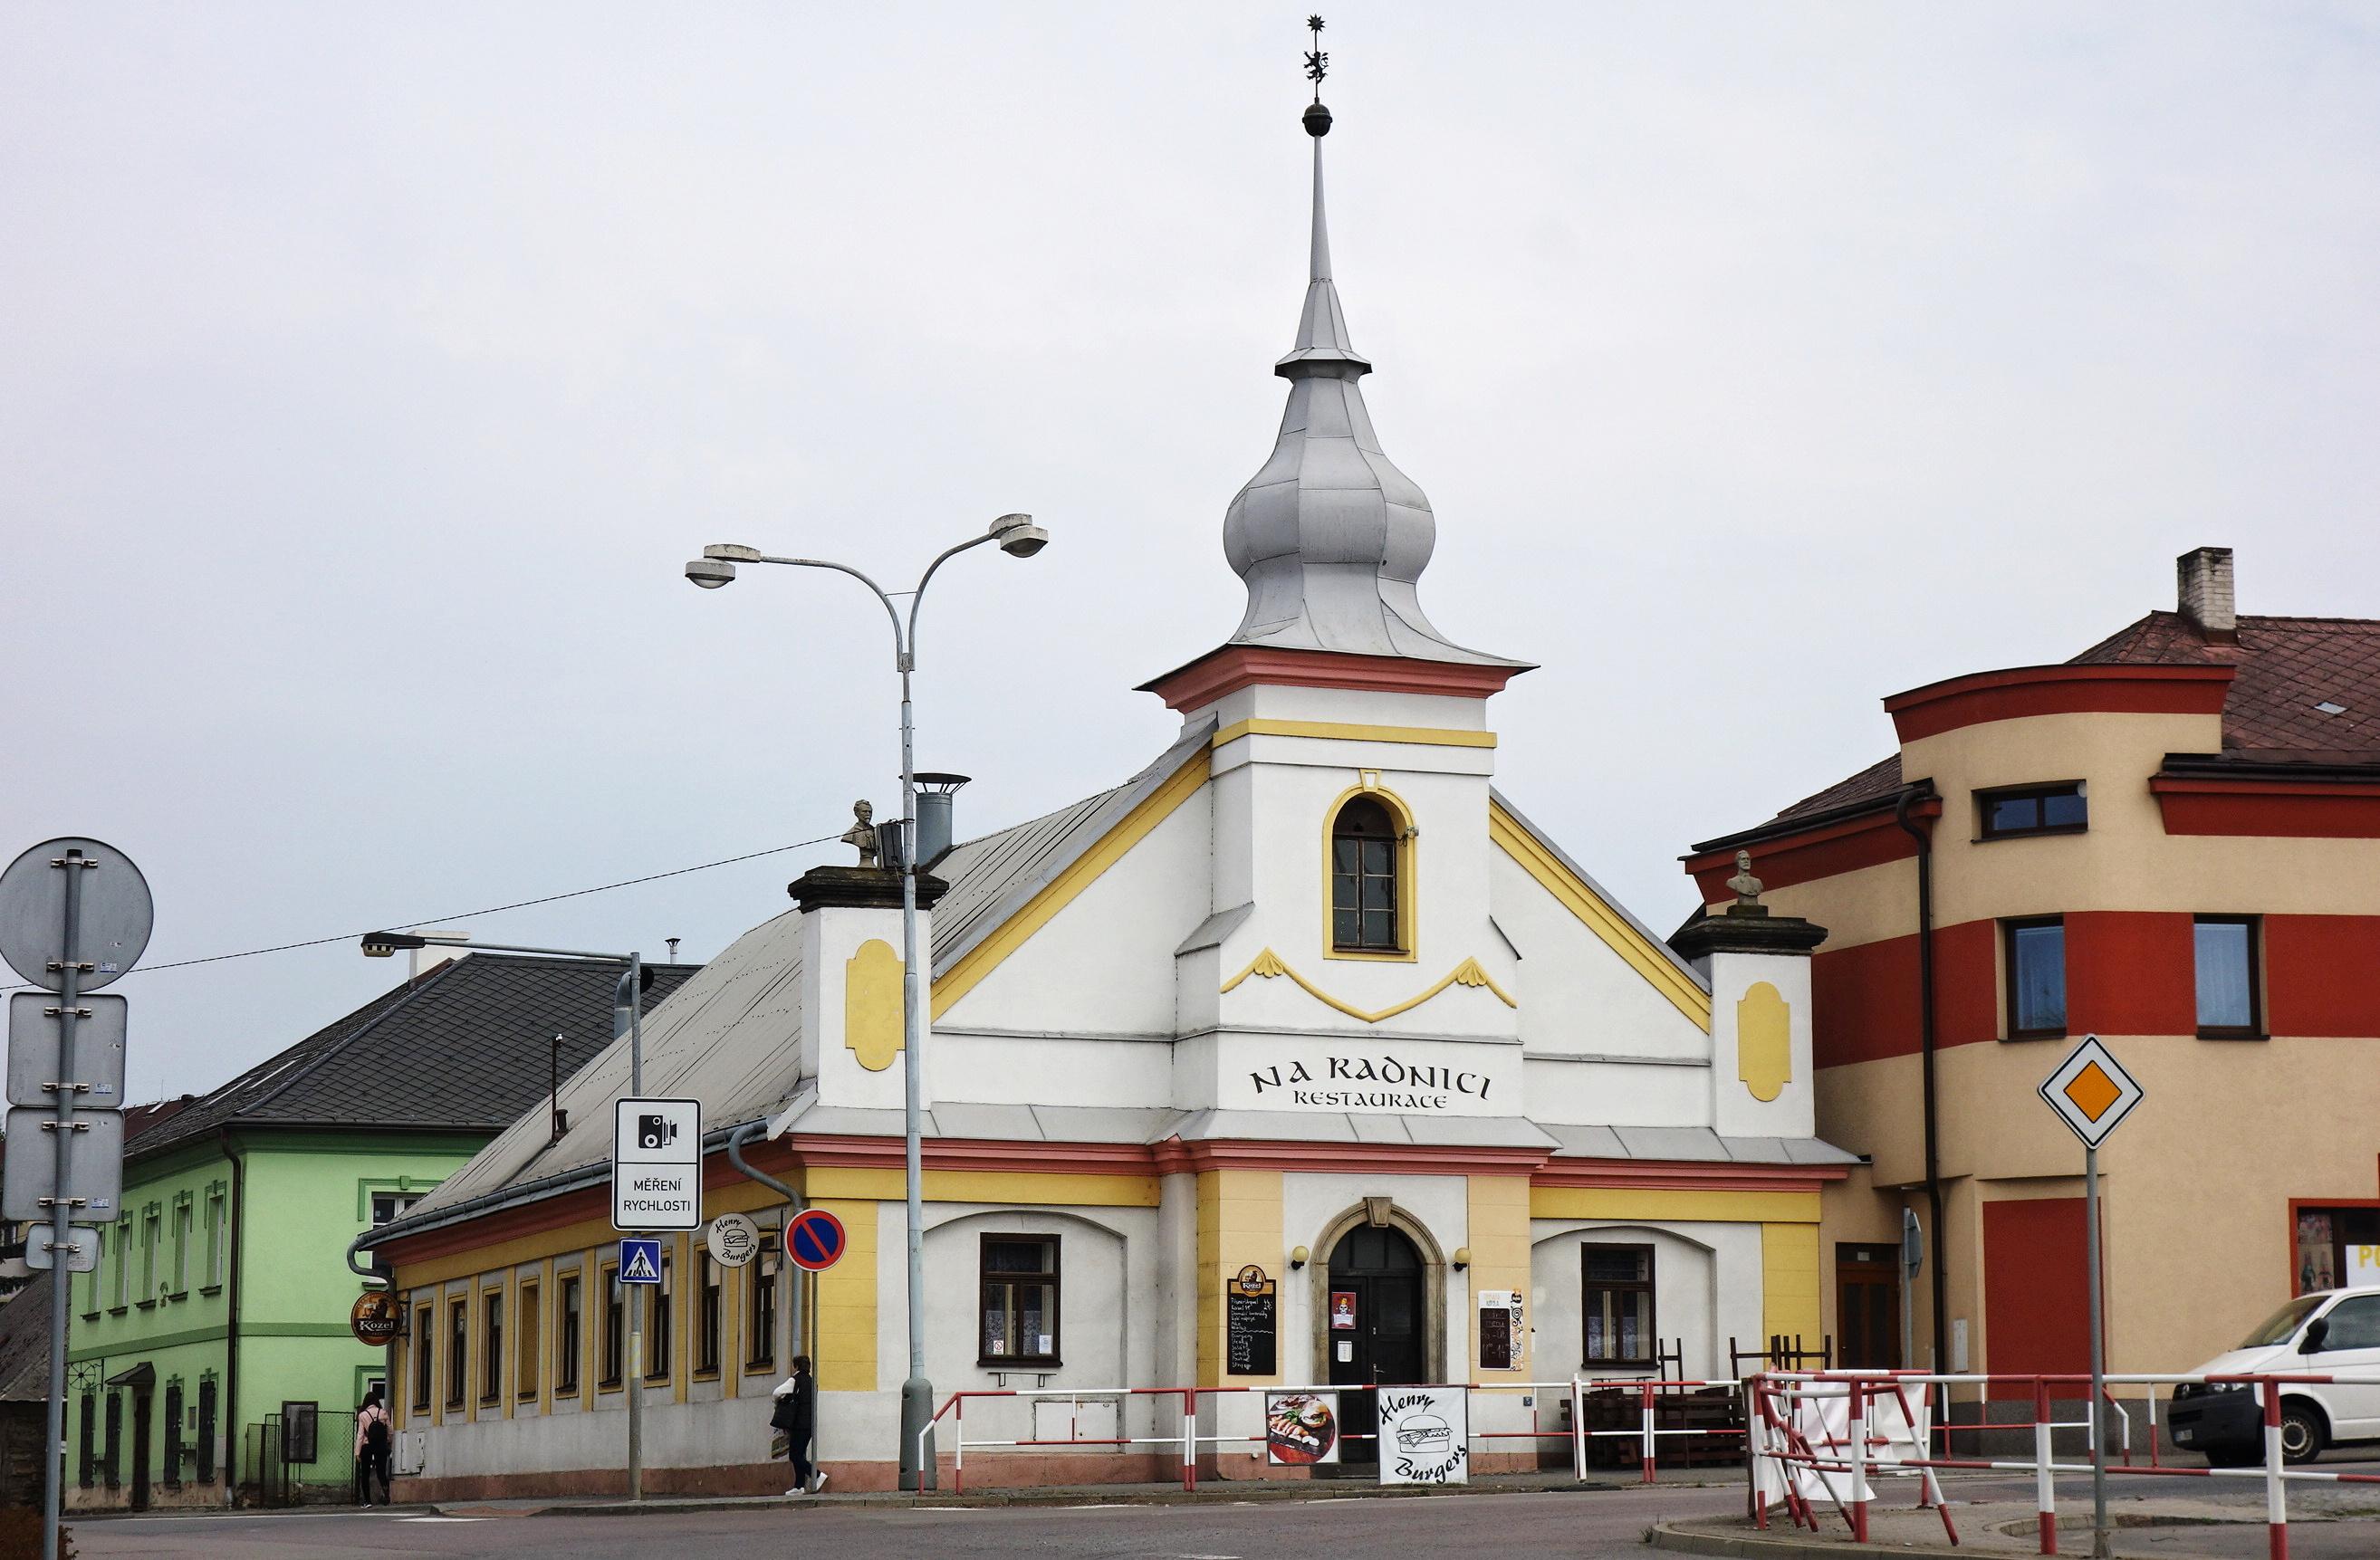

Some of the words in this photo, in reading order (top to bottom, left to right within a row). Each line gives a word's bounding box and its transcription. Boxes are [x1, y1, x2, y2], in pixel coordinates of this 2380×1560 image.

[1250, 1061, 1313, 1094] NA
[1326, 1056, 1492, 1100] RADNICI
[1294, 1090, 1448, 1108] RESTAURACE
[634, 1177, 681, 1192] MĚŘENÍ
[623, 1200, 691, 1211] RYCHLOSTI
[715, 1217, 743, 1234] Henry
[722, 1243, 756, 1263] Burgers
[360, 1320, 394, 1331] Kozel
[1379, 1393, 1435, 1425] Henry
[1395, 1444, 1468, 1484] Burgers
